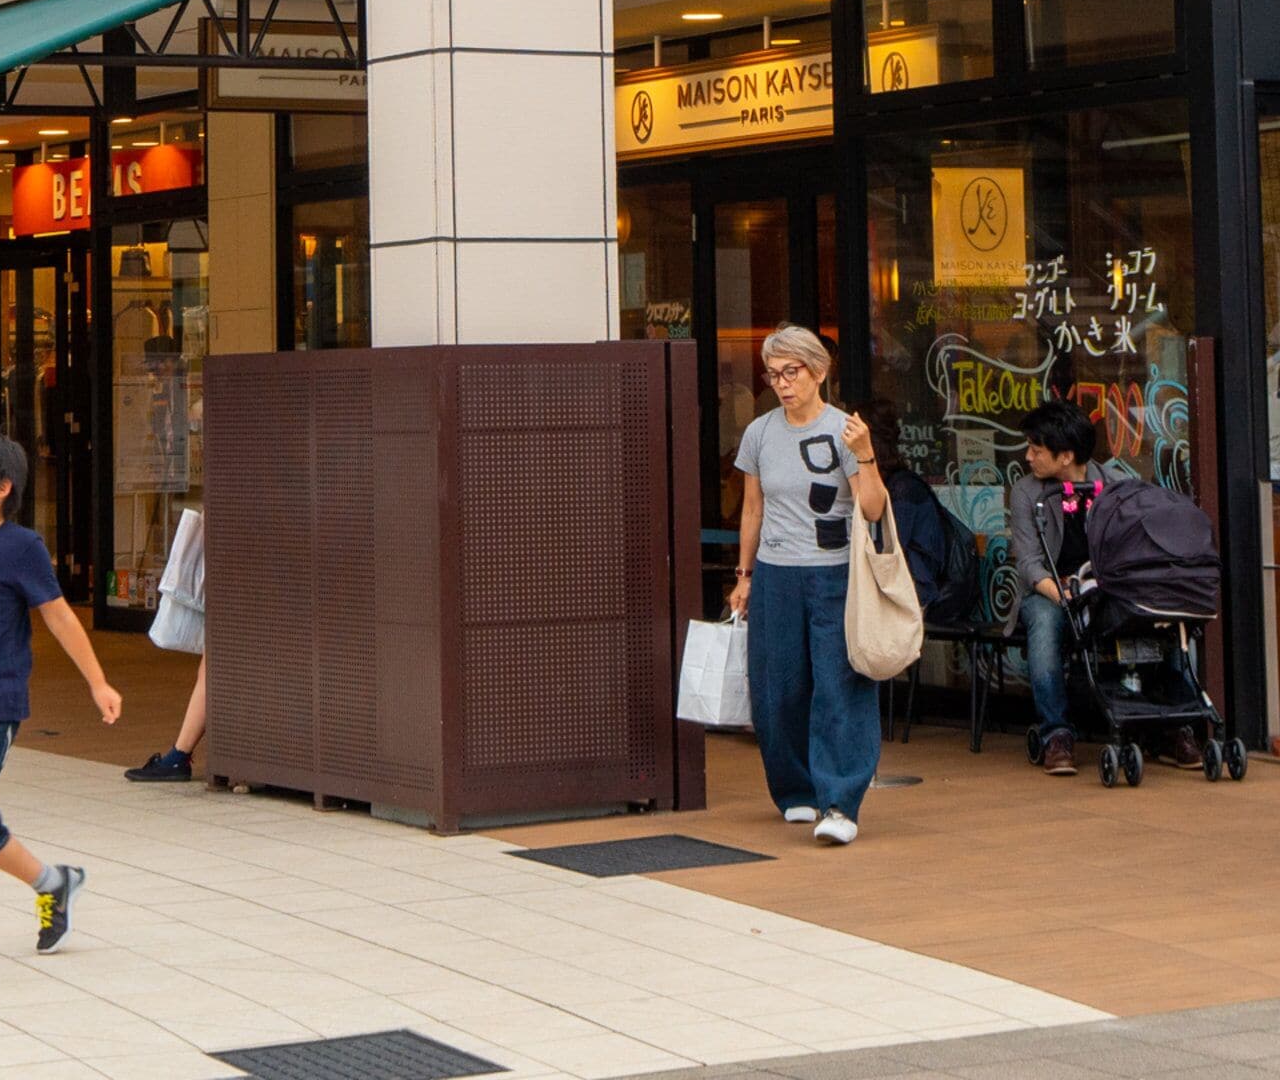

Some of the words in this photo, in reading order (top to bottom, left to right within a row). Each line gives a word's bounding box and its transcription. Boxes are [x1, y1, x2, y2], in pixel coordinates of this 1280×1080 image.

[338, 74, 368, 86] PA
[678, 72, 757, 109] MAISON
[741, 105, 785, 126] PARIS
[941, 261, 983, 270] MAISON
[986, 262, 1026, 271] KAYSE
